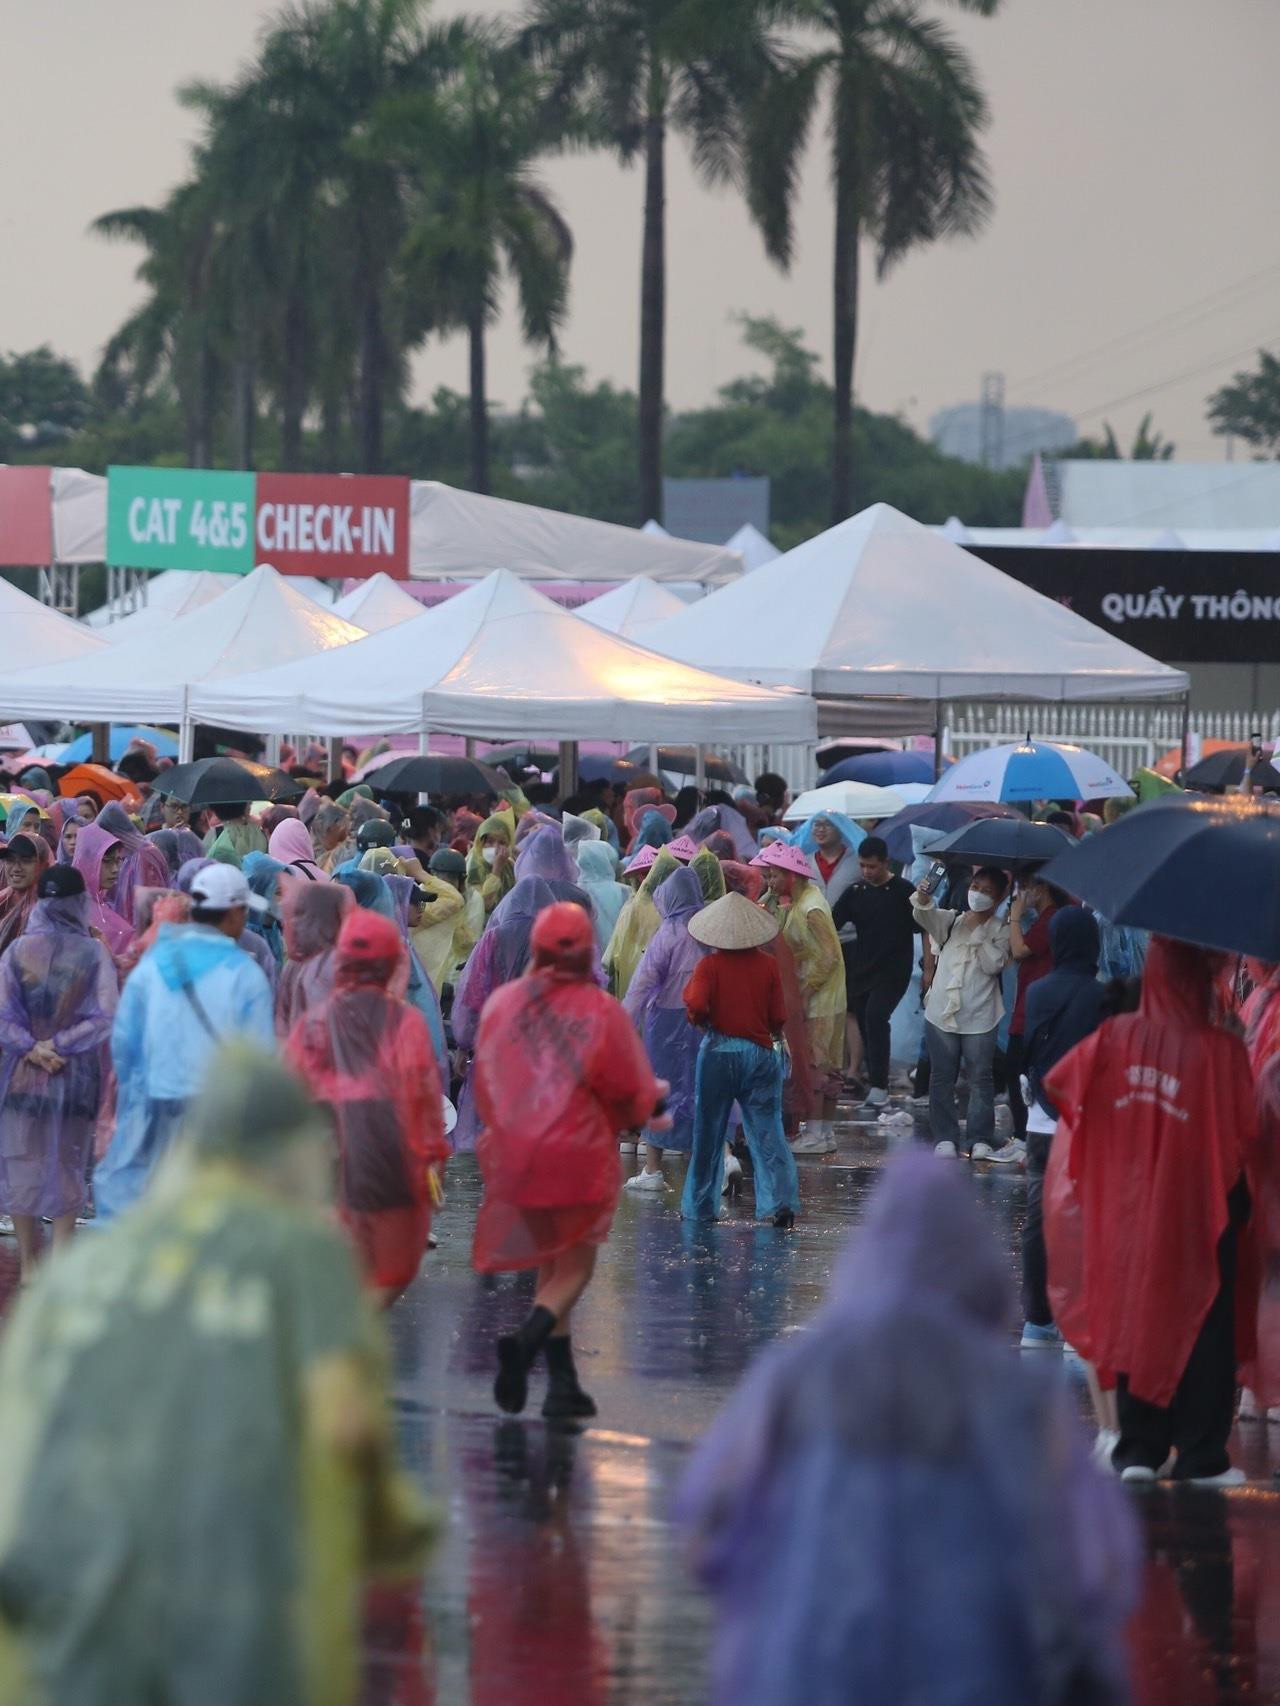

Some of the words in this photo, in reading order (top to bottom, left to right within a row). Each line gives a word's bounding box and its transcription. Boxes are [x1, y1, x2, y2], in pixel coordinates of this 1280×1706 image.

[128, 497, 182, 544] CAT
[189, 499, 248, 548] 4&5
[257, 503, 395, 556] CHECK-IN
